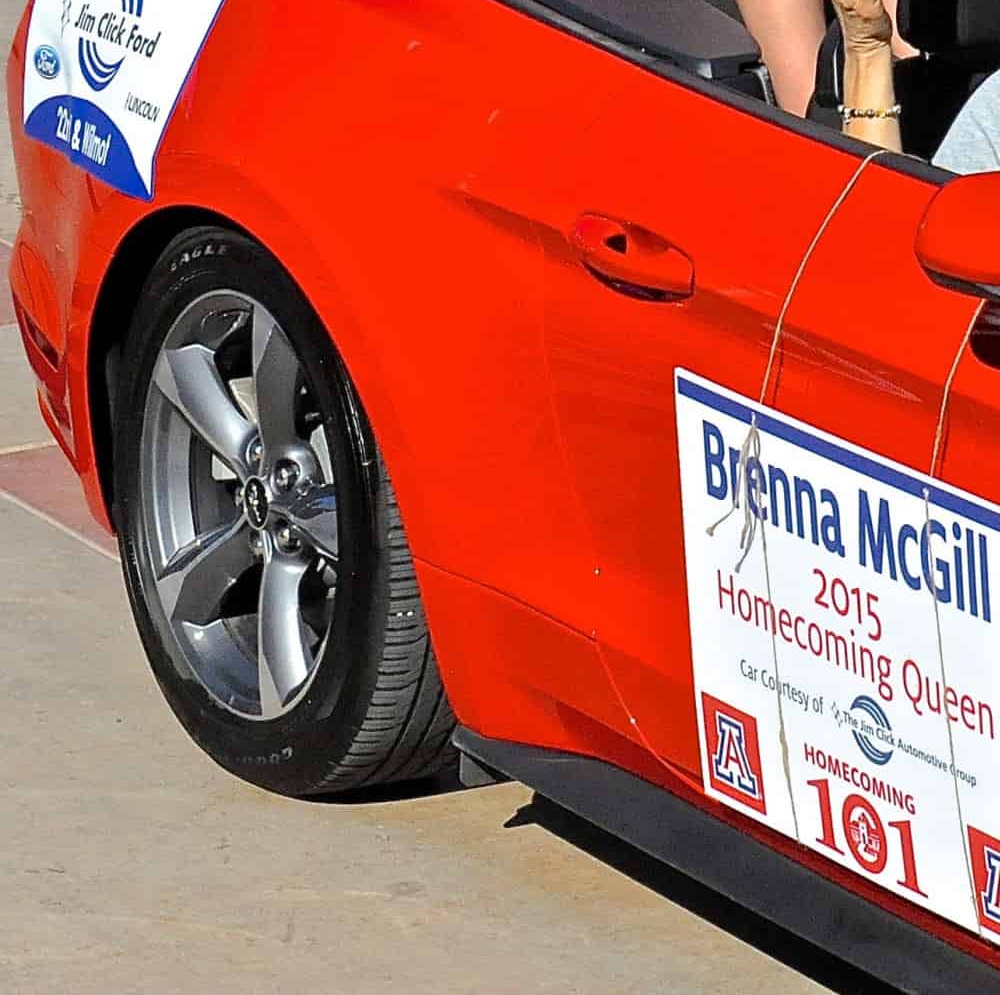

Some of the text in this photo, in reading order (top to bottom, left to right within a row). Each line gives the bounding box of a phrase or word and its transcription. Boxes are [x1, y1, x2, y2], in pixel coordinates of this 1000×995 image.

[74, 4, 161, 58] Jim Click Ford
[71, 118, 81, 151] &
[127, 94, 160, 123] LINCOLN
[171, 244, 228, 272] EAGLE
[702, 419, 991, 623] Brenna McGill
[813, 567, 882, 641] 2015
[717, 569, 994, 740] Homecoming Queen
[740, 659, 758, 682] Car
[812, 696, 824, 715] of
[712, 711, 759, 797] A
[804, 742, 916, 815] HOMECOMING
[843, 710, 977, 788] The Jim Click Automotive Group
[807, 778, 928, 899] 101
